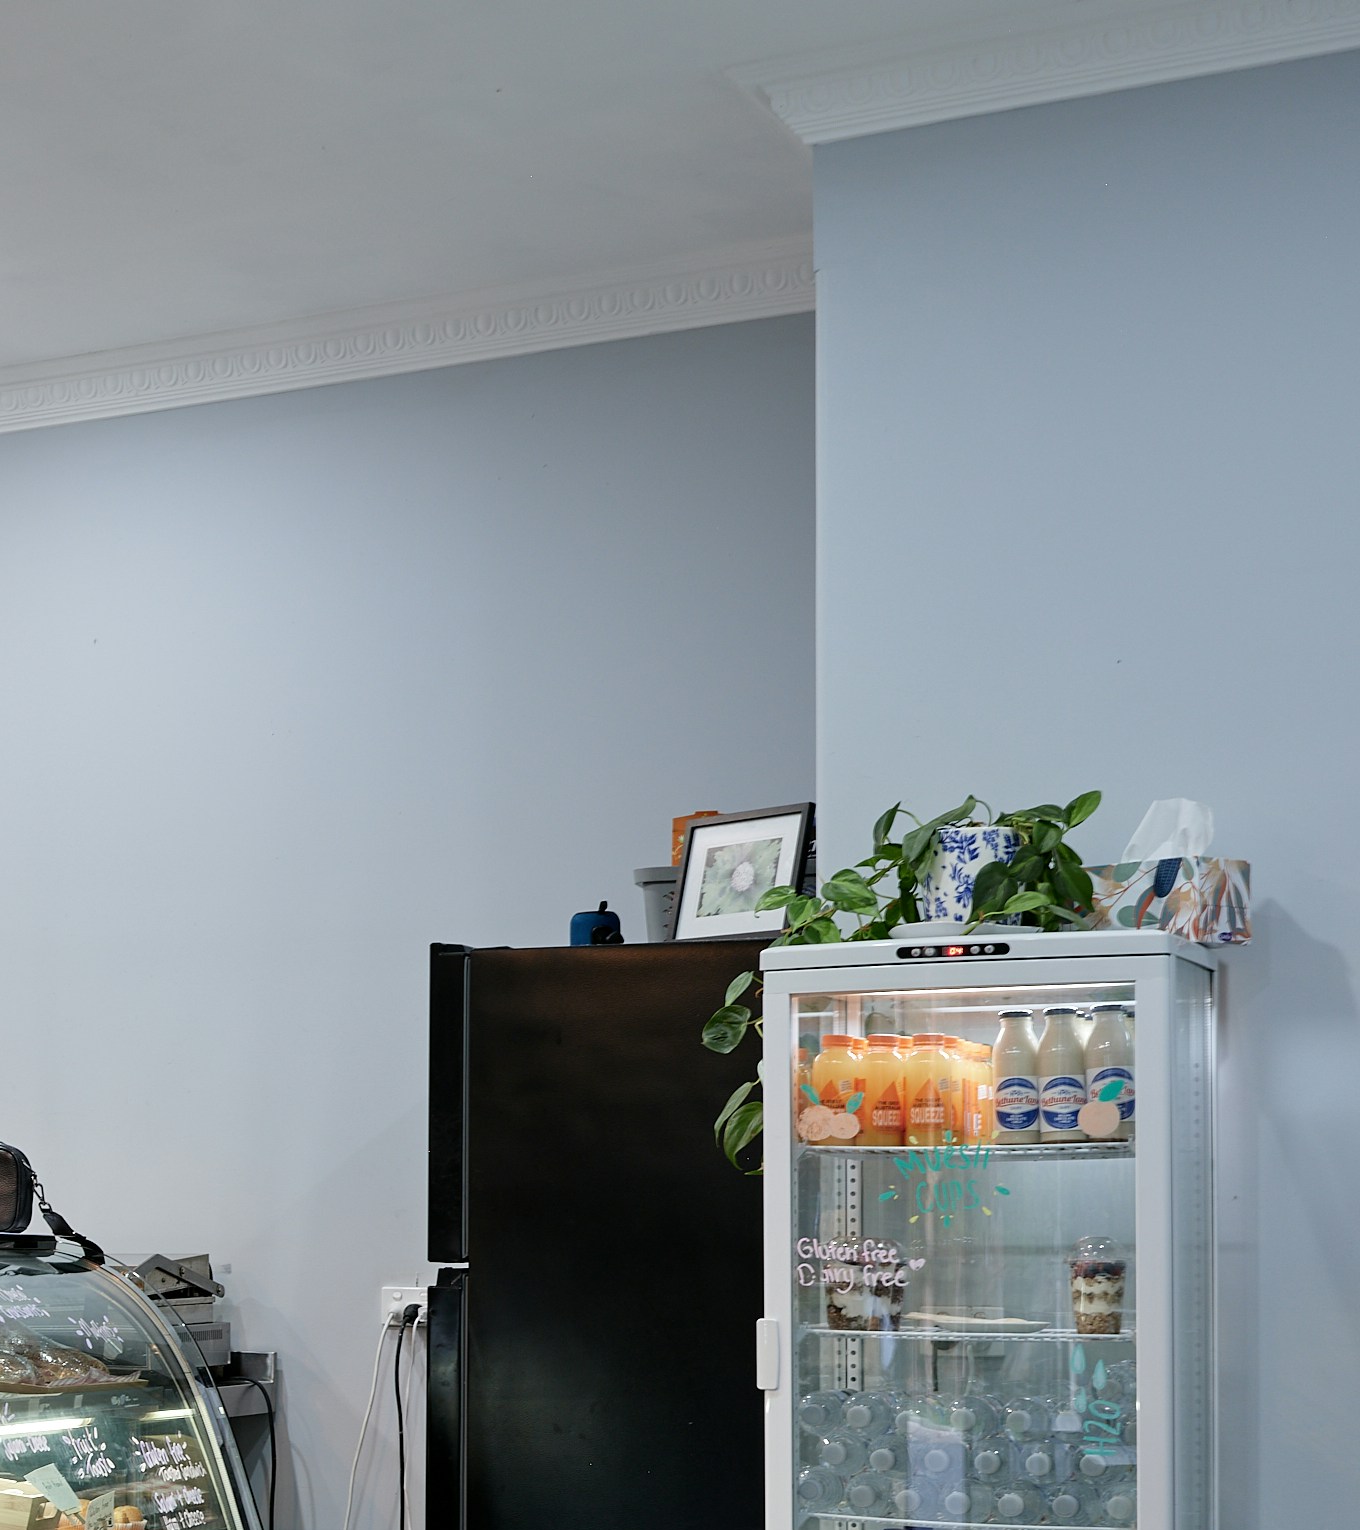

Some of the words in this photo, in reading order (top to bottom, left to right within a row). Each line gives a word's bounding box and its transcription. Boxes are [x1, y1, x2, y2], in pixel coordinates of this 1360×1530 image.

[915, 1180, 981, 1214] CUPS
[796, 1236, 859, 1262] Gluten
[861, 1239, 900, 1264] free
[796, 1262, 855, 1294] Dairy
[862, 1264, 910, 1287] free
[1083, 1399, 1121, 1457] H2O
